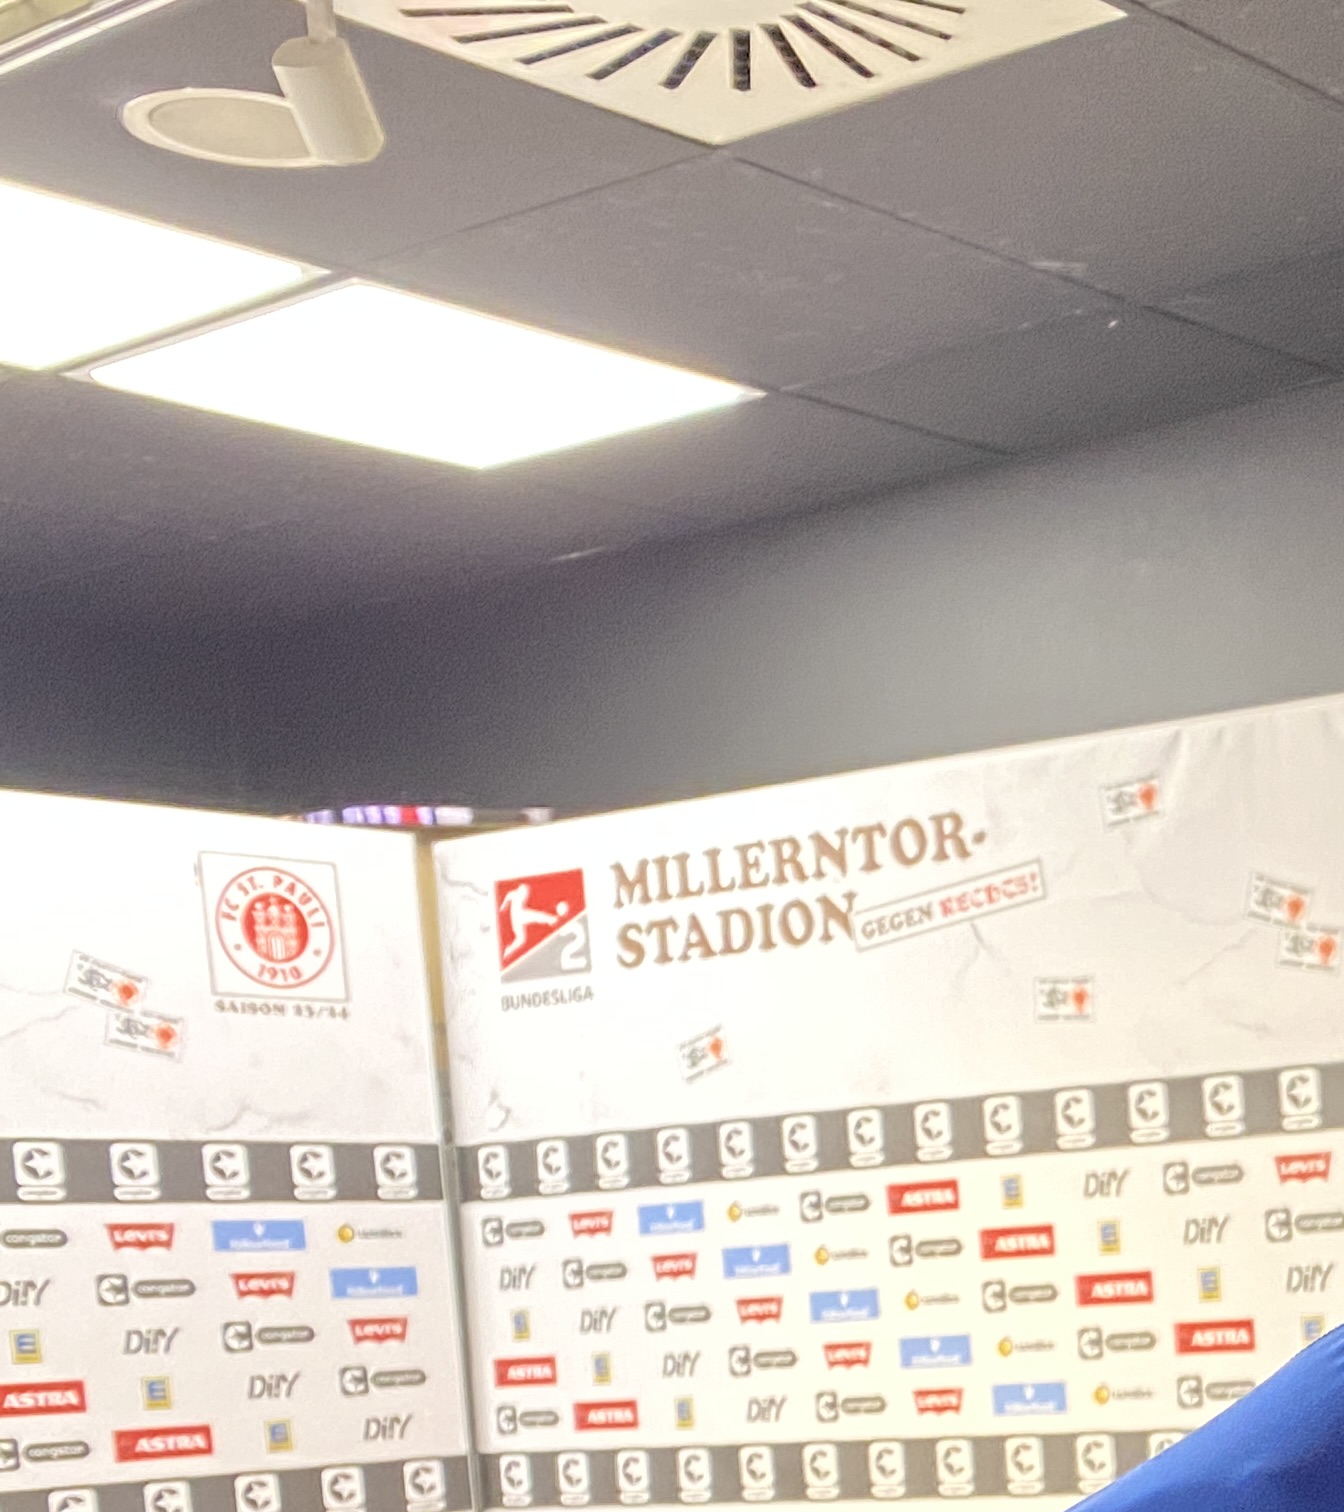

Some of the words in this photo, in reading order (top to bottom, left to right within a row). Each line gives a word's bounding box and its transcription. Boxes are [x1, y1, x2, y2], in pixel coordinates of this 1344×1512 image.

[610, 810, 988, 909] MILLERNTOR-
[221, 898, 241, 921] FC
[237, 876, 264, 895] ST.
[272, 875, 325, 928] PAULI
[617, 891, 858, 969] STADION
[861, 903, 934, 941] GEGEN
[257, 964, 302, 983] 1910
[503, 987, 594, 1011] BUNDESLIGA
[4, 1391, 78, 1407] ASTRA
[137, 1435, 205, 1451] ASTRA
